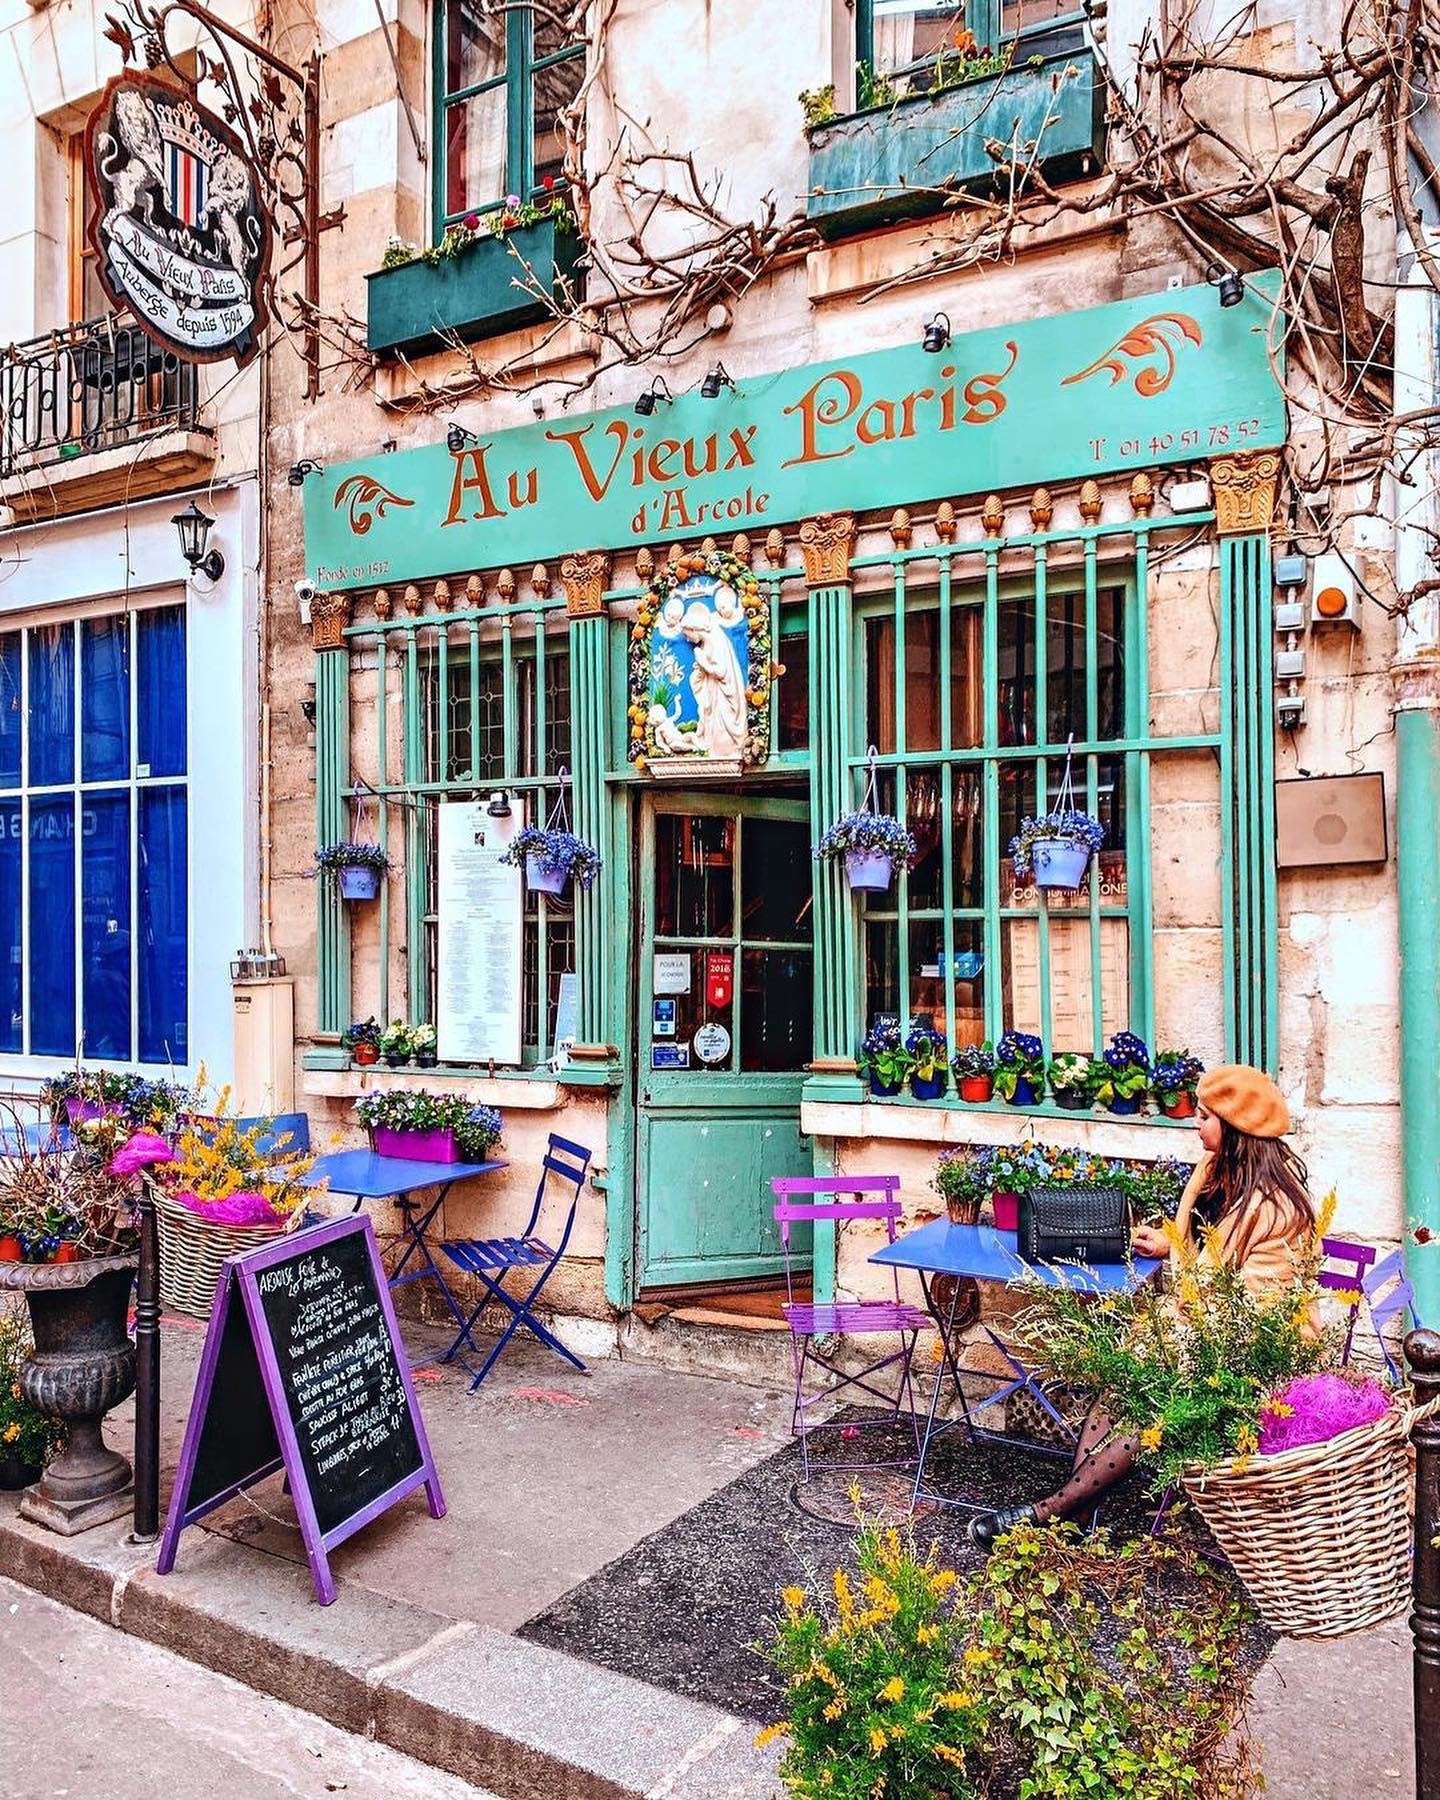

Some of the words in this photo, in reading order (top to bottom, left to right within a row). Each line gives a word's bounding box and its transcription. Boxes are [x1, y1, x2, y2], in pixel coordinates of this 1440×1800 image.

[125, 230, 150, 261] Au
[154, 246, 194, 290] Vieux
[198, 268, 236, 296] Paris
[115, 259, 169, 319] Auberge
[176, 314, 218, 340] depuis
[219, 308, 245, 336] 1594
[440, 442, 538, 528] Au
[545, 420, 758, 503] Vieux
[780, 341, 1018, 469] Paris
[1120, 440, 1141, 456] 01
[1148, 434, 1174, 457] 40
[1180, 429, 1199, 450] 51
[1208, 424, 1230, 447] 78
[1236, 418, 1259, 443] 52
[630, 485, 770, 536] d'Arcole
